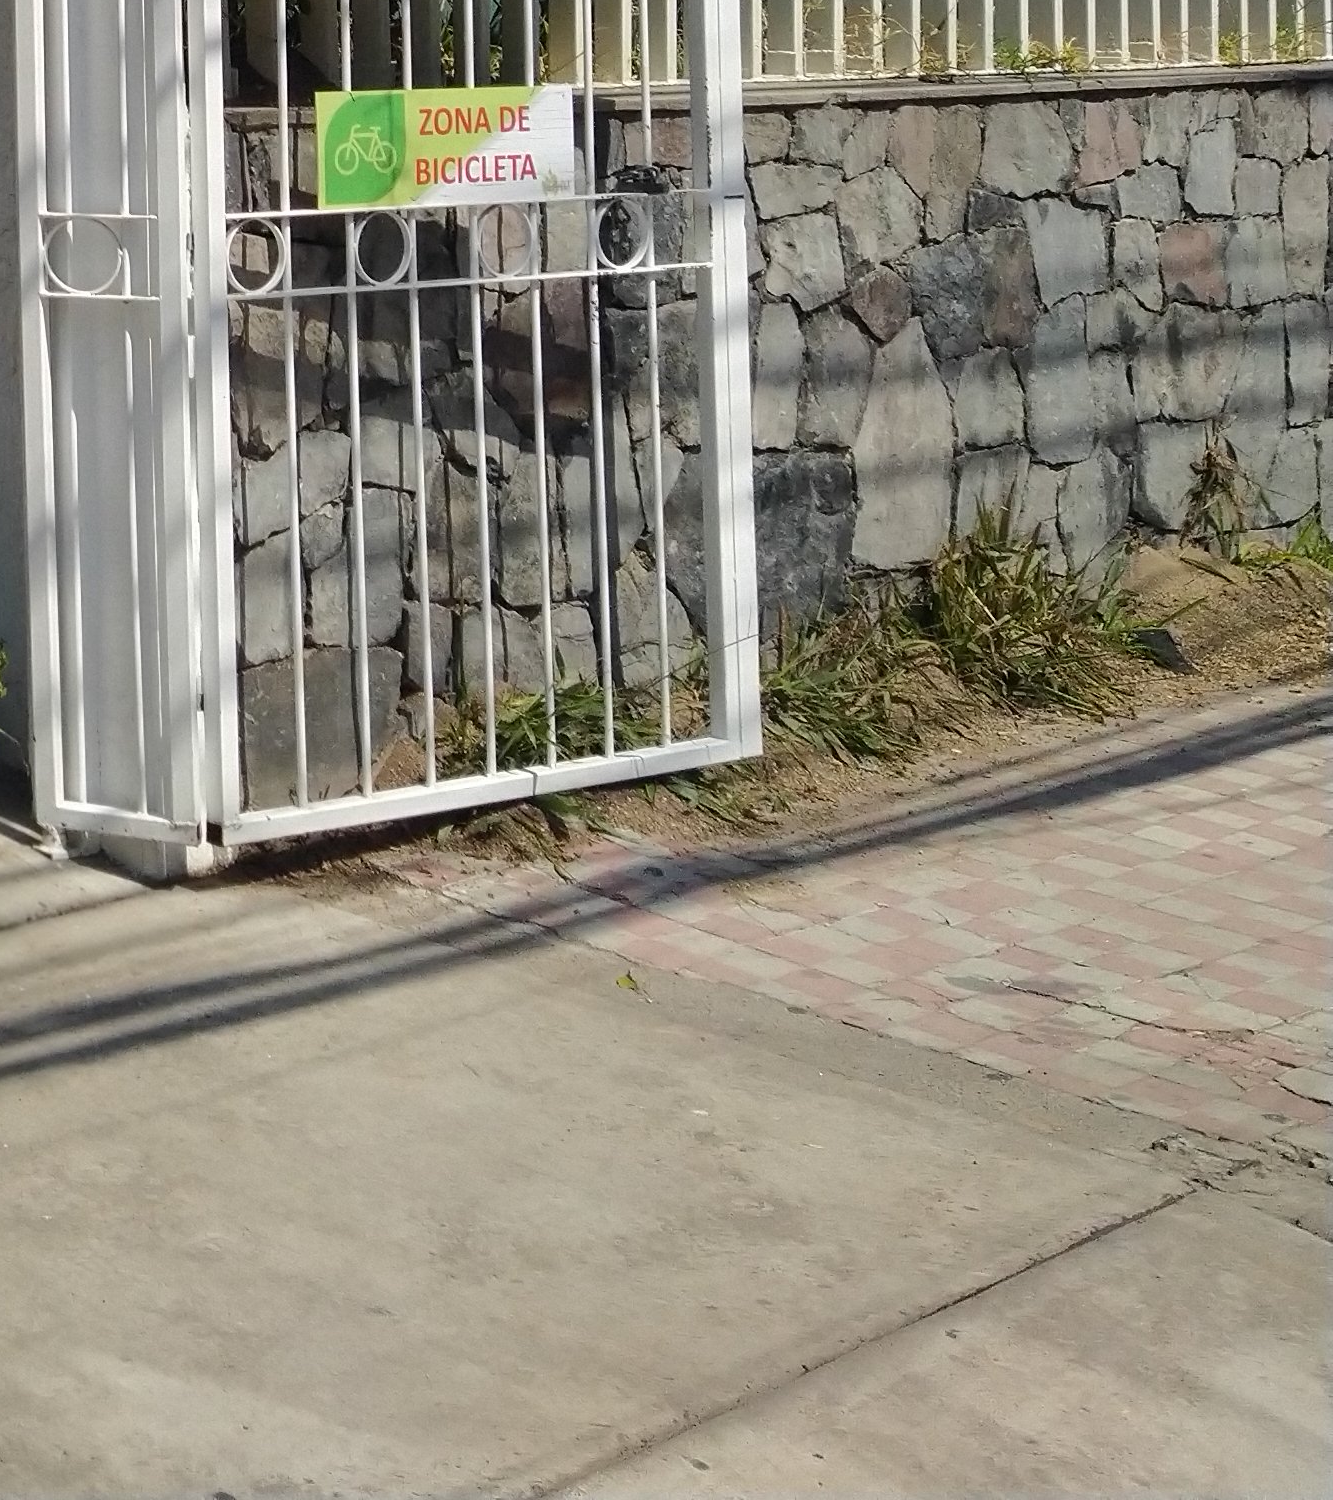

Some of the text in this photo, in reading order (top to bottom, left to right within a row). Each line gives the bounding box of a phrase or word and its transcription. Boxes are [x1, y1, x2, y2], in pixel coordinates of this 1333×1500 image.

[419, 105, 530, 135] ZONA DE
[415, 154, 537, 185] BICICLETA
